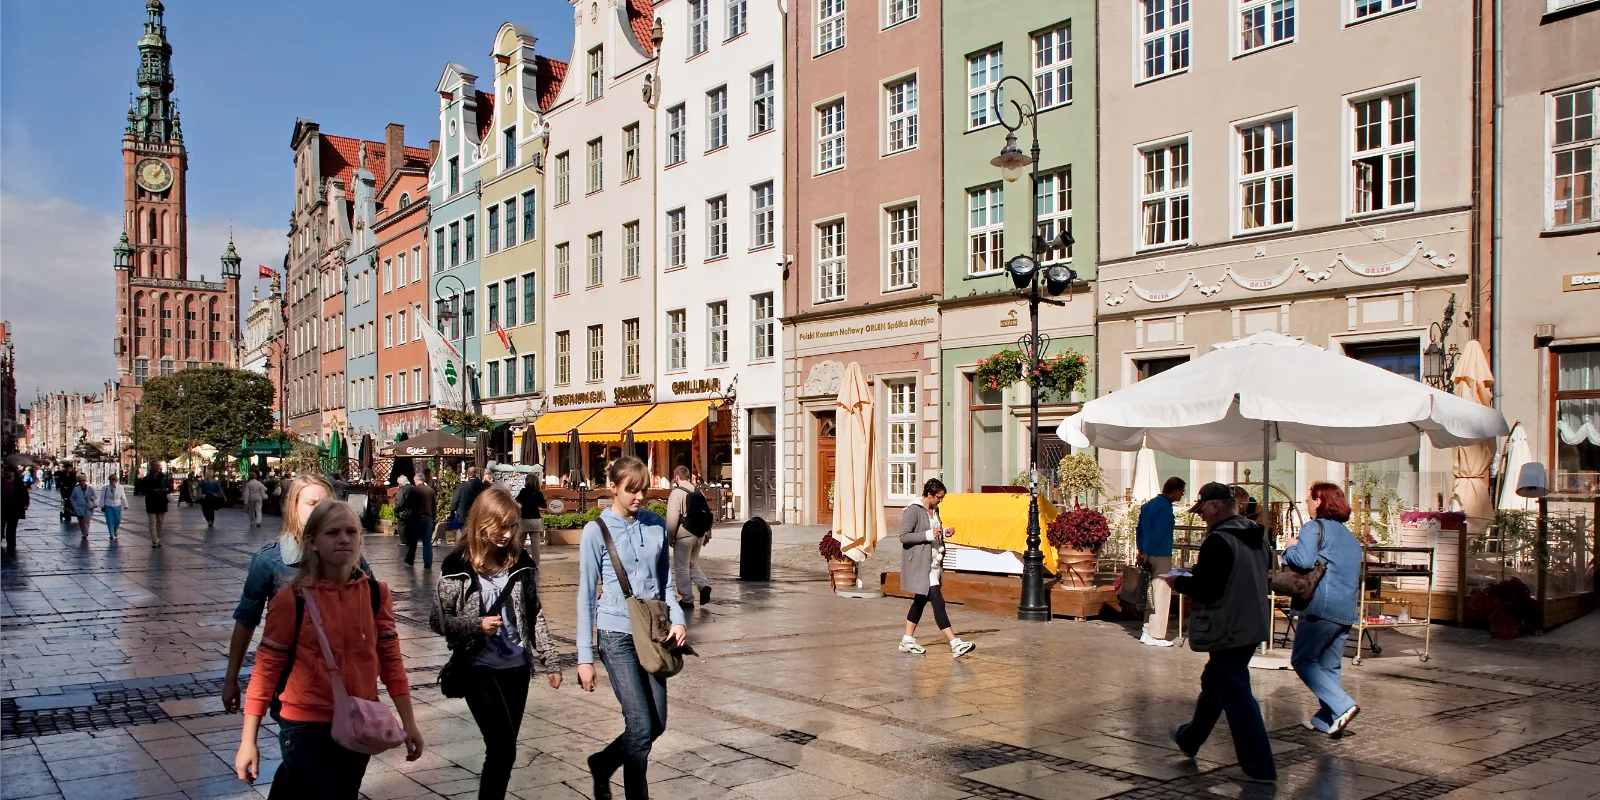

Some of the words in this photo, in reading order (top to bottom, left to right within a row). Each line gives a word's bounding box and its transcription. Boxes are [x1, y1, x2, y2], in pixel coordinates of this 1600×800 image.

[1365, 266, 1391, 274] ORLEN
[799, 331, 815, 340] Polski
[815, 330, 839, 339] Koncern
[839, 326, 864, 336] Naftowy
[865, 323, 886, 333] ORLEN
[887, 319, 909, 331] Spółka
[909, 316, 935, 327] Akcyjna
